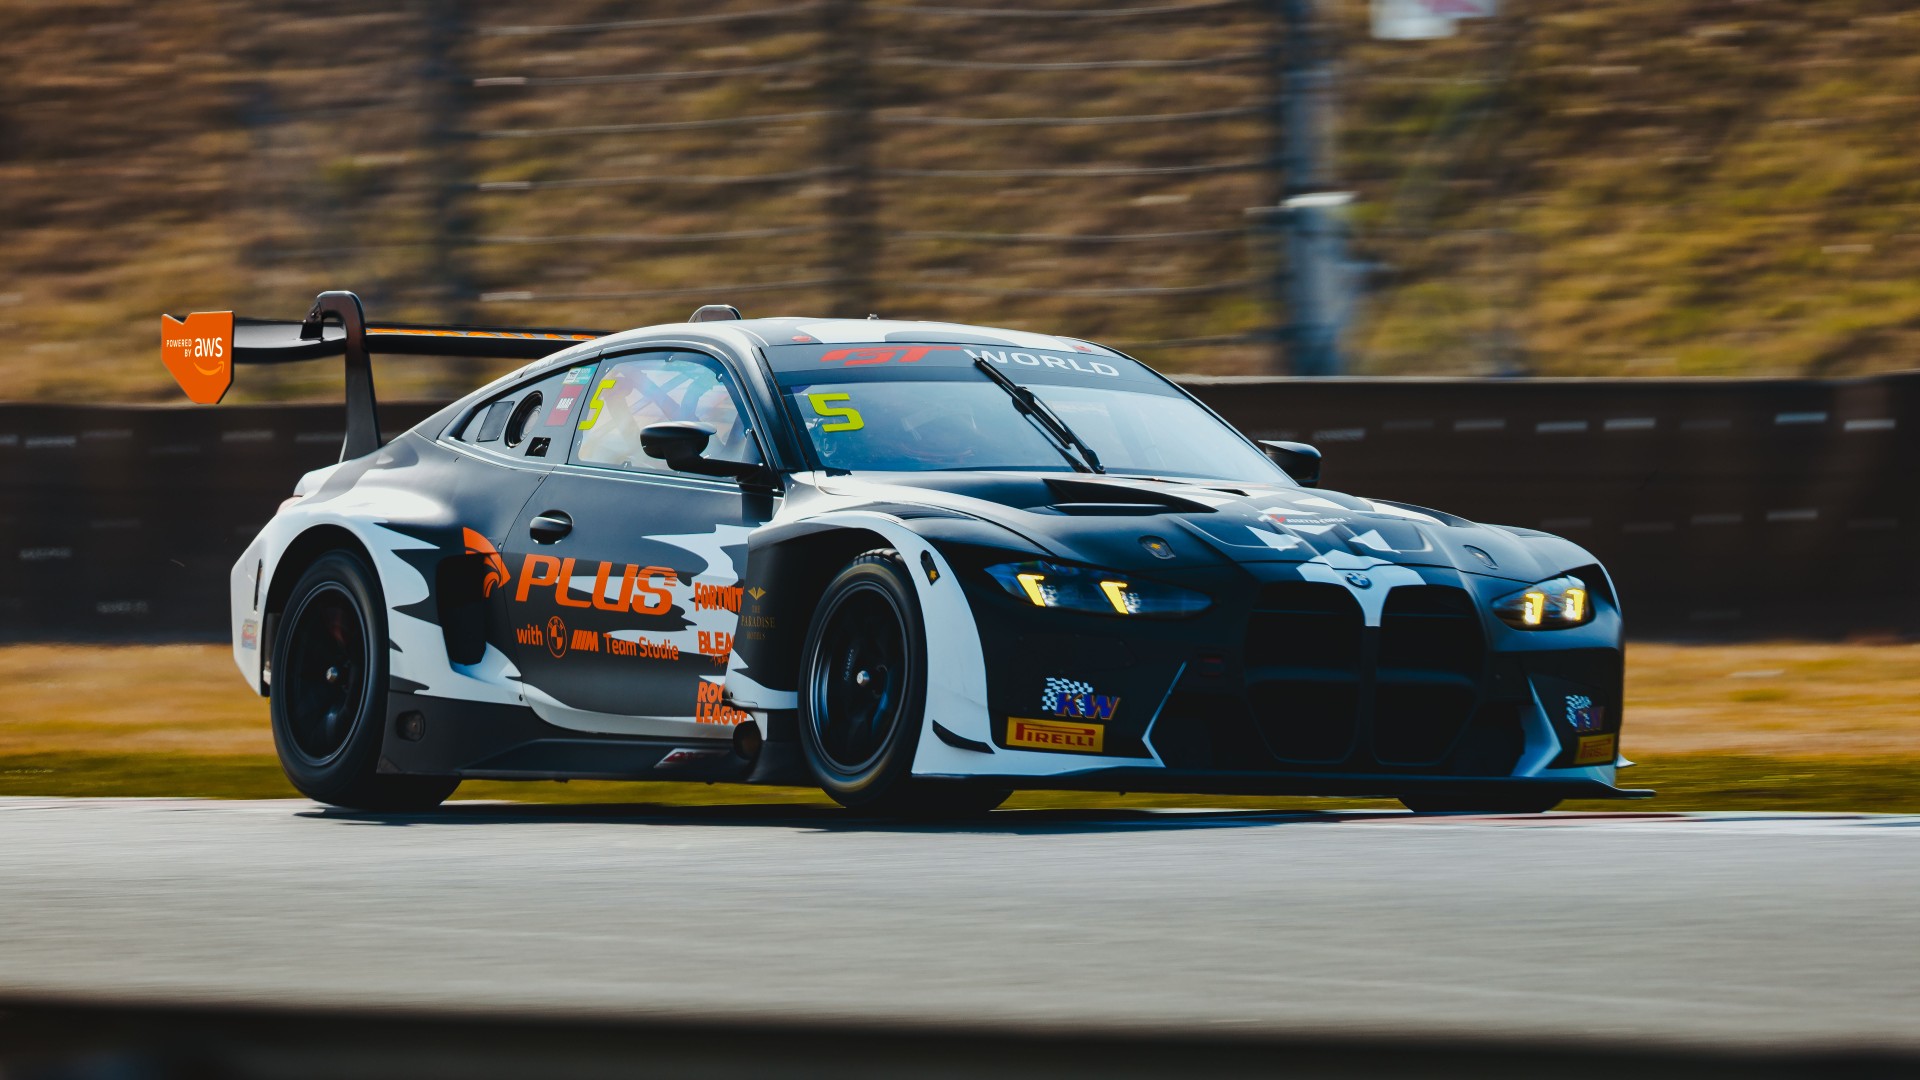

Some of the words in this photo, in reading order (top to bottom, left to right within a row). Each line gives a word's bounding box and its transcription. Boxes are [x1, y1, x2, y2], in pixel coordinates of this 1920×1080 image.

[166, 338, 193, 347] POWERED
[184, 348, 192, 358] BY
[194, 336, 223, 358] aws
[963, 347, 1120, 377] WORLD
[578, 379, 617, 431] 5
[807, 392, 865, 433] 5
[515, 553, 678, 616] PLUS
[694, 581, 744, 614] FORTNIT
[516, 623, 543, 646] with
[602, 632, 637, 657] Team
[639, 635, 679, 661] Studie
[698, 630, 735, 655] BLEA
[1054, 692, 1121, 720] KW
[1015, 722, 1097, 747] PIRELLI
